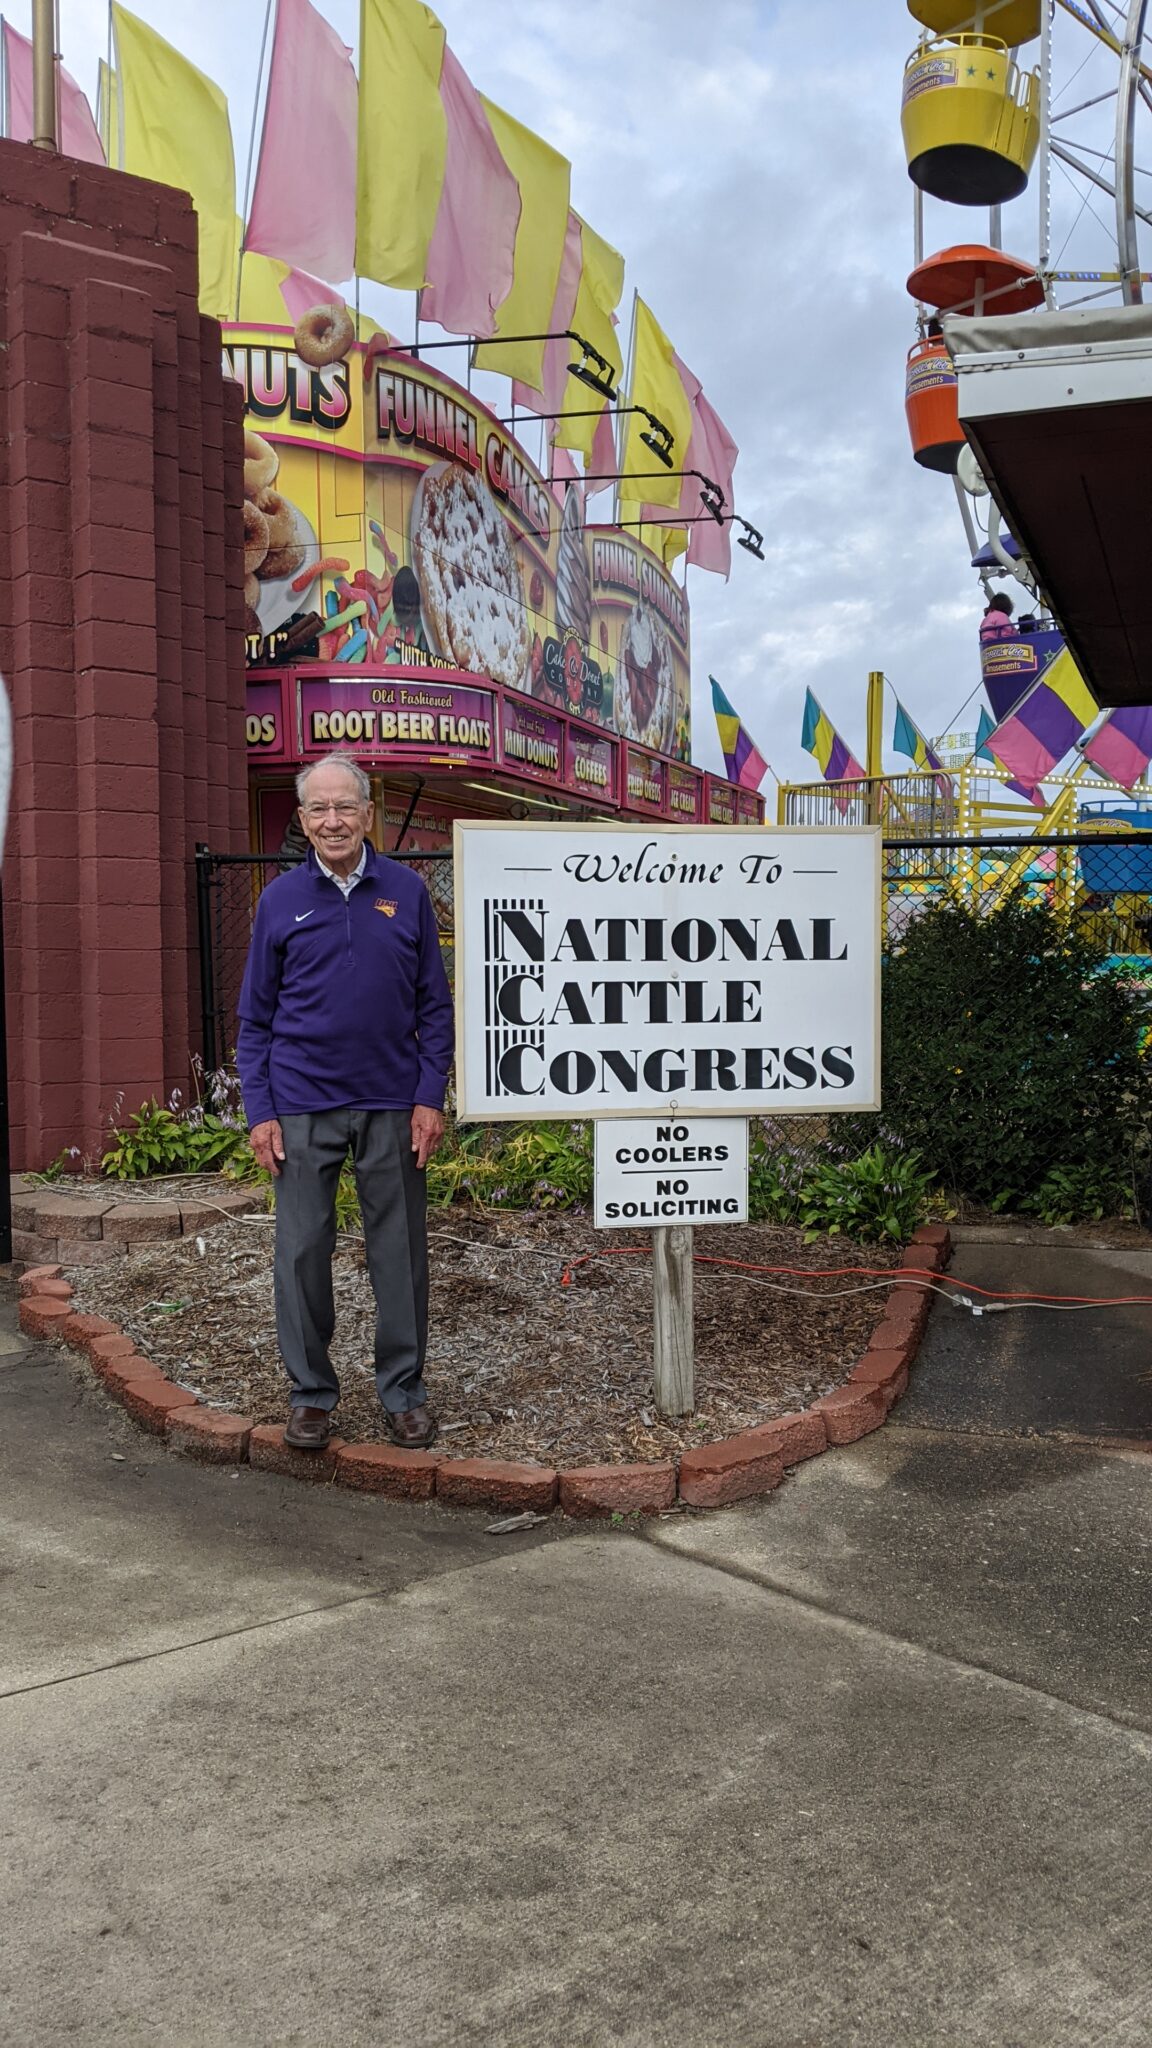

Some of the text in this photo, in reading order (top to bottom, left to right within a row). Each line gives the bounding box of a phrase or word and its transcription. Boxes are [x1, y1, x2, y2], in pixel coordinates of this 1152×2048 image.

[377, 370, 550, 542] FUNNEL CAKES
[593, 541, 639, 593] FUNNEL
[546, 643, 566, 669] Cake
[371, 688, 453, 708] Old Fashioned
[313, 710, 491, 749] ROOT BEER FLOATS
[504, 728, 526, 759] MINI
[527, 736, 559, 770] DONUTS
[575, 755, 607, 786] COFFEES
[563, 841, 783, 885] Welcome To
[375, 897, 399, 909] UNI
[495, 910, 849, 962] NATIONAL
[497, 973, 762, 1026] CATTLE
[498, 1043, 855, 1096] CONGRESS
[656, 1125, 689, 1142] NO
[615, 1145, 729, 1164] COOLERS
[656, 1179, 690, 1196] NO
[605, 1198, 739, 1219] SOLICITING
